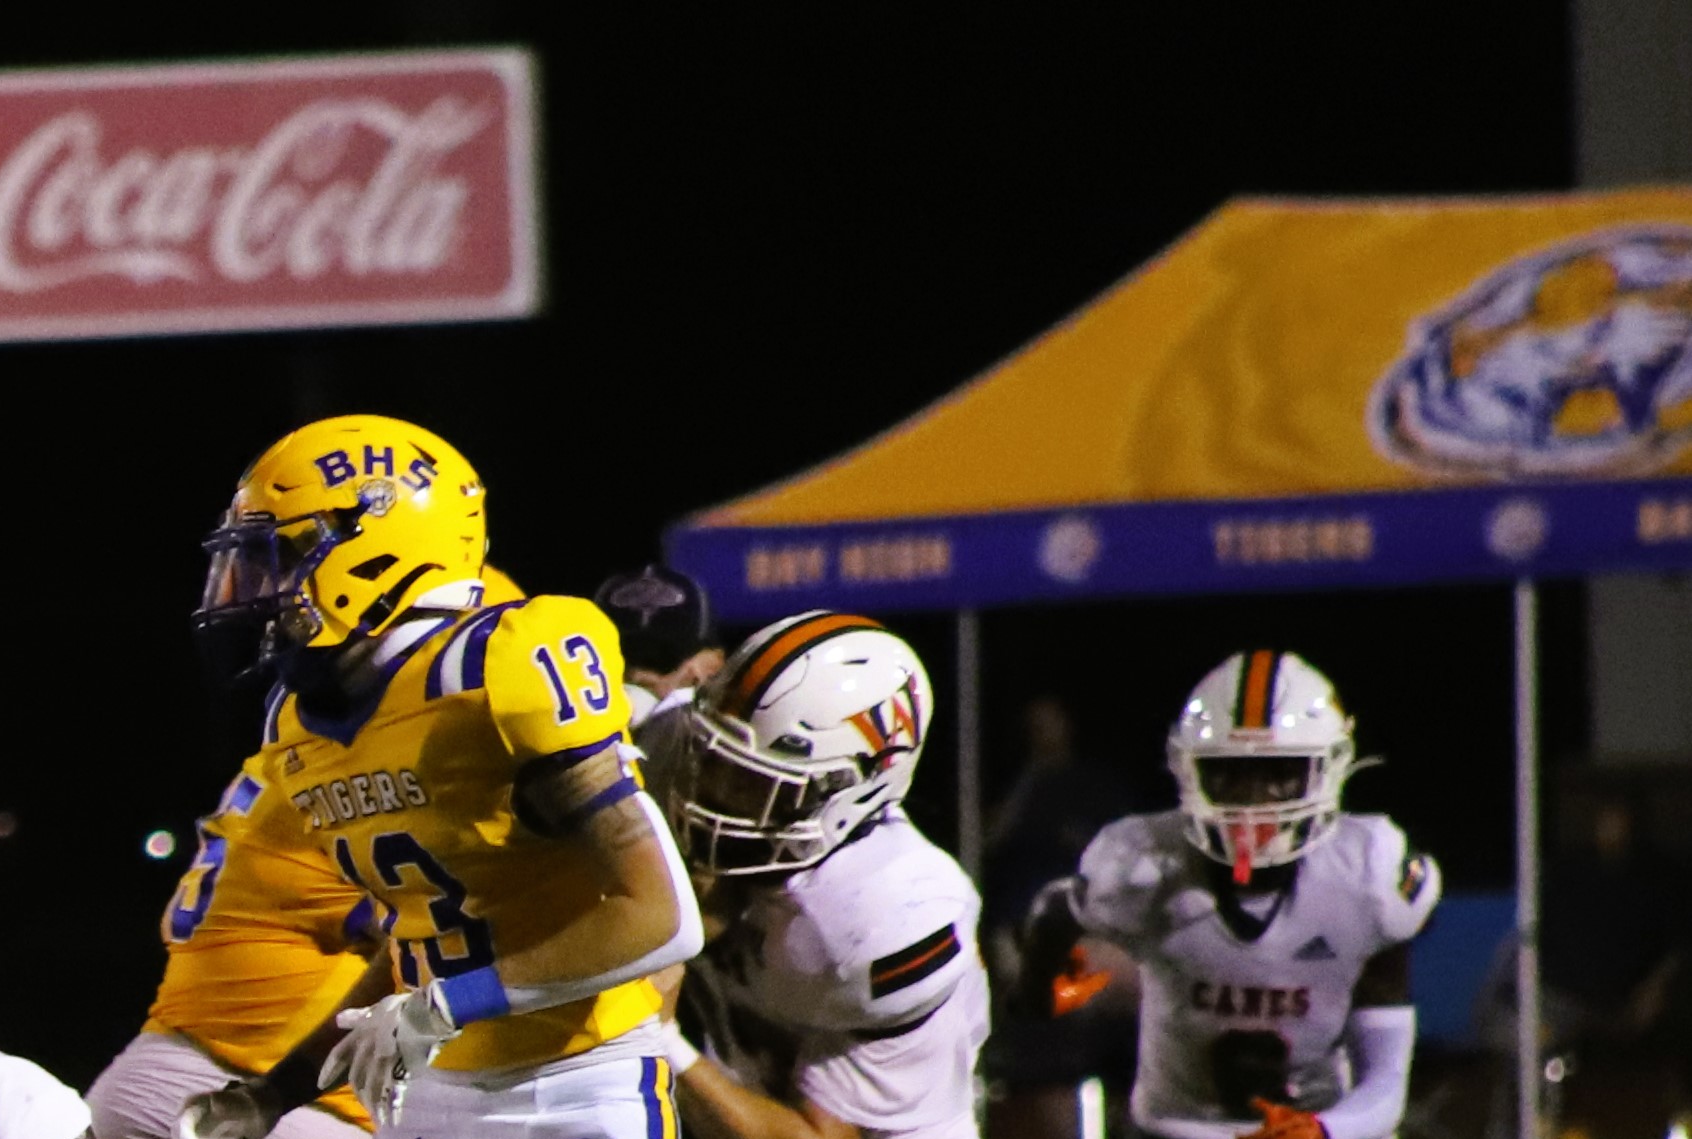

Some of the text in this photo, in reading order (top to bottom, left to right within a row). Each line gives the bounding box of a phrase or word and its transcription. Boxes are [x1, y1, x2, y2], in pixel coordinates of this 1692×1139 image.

[314, 444, 439, 494] BHS
[531, 632, 612, 726] 13
[291, 768, 428, 828] TIGERS
[1191, 981, 1310, 1018] CANES
